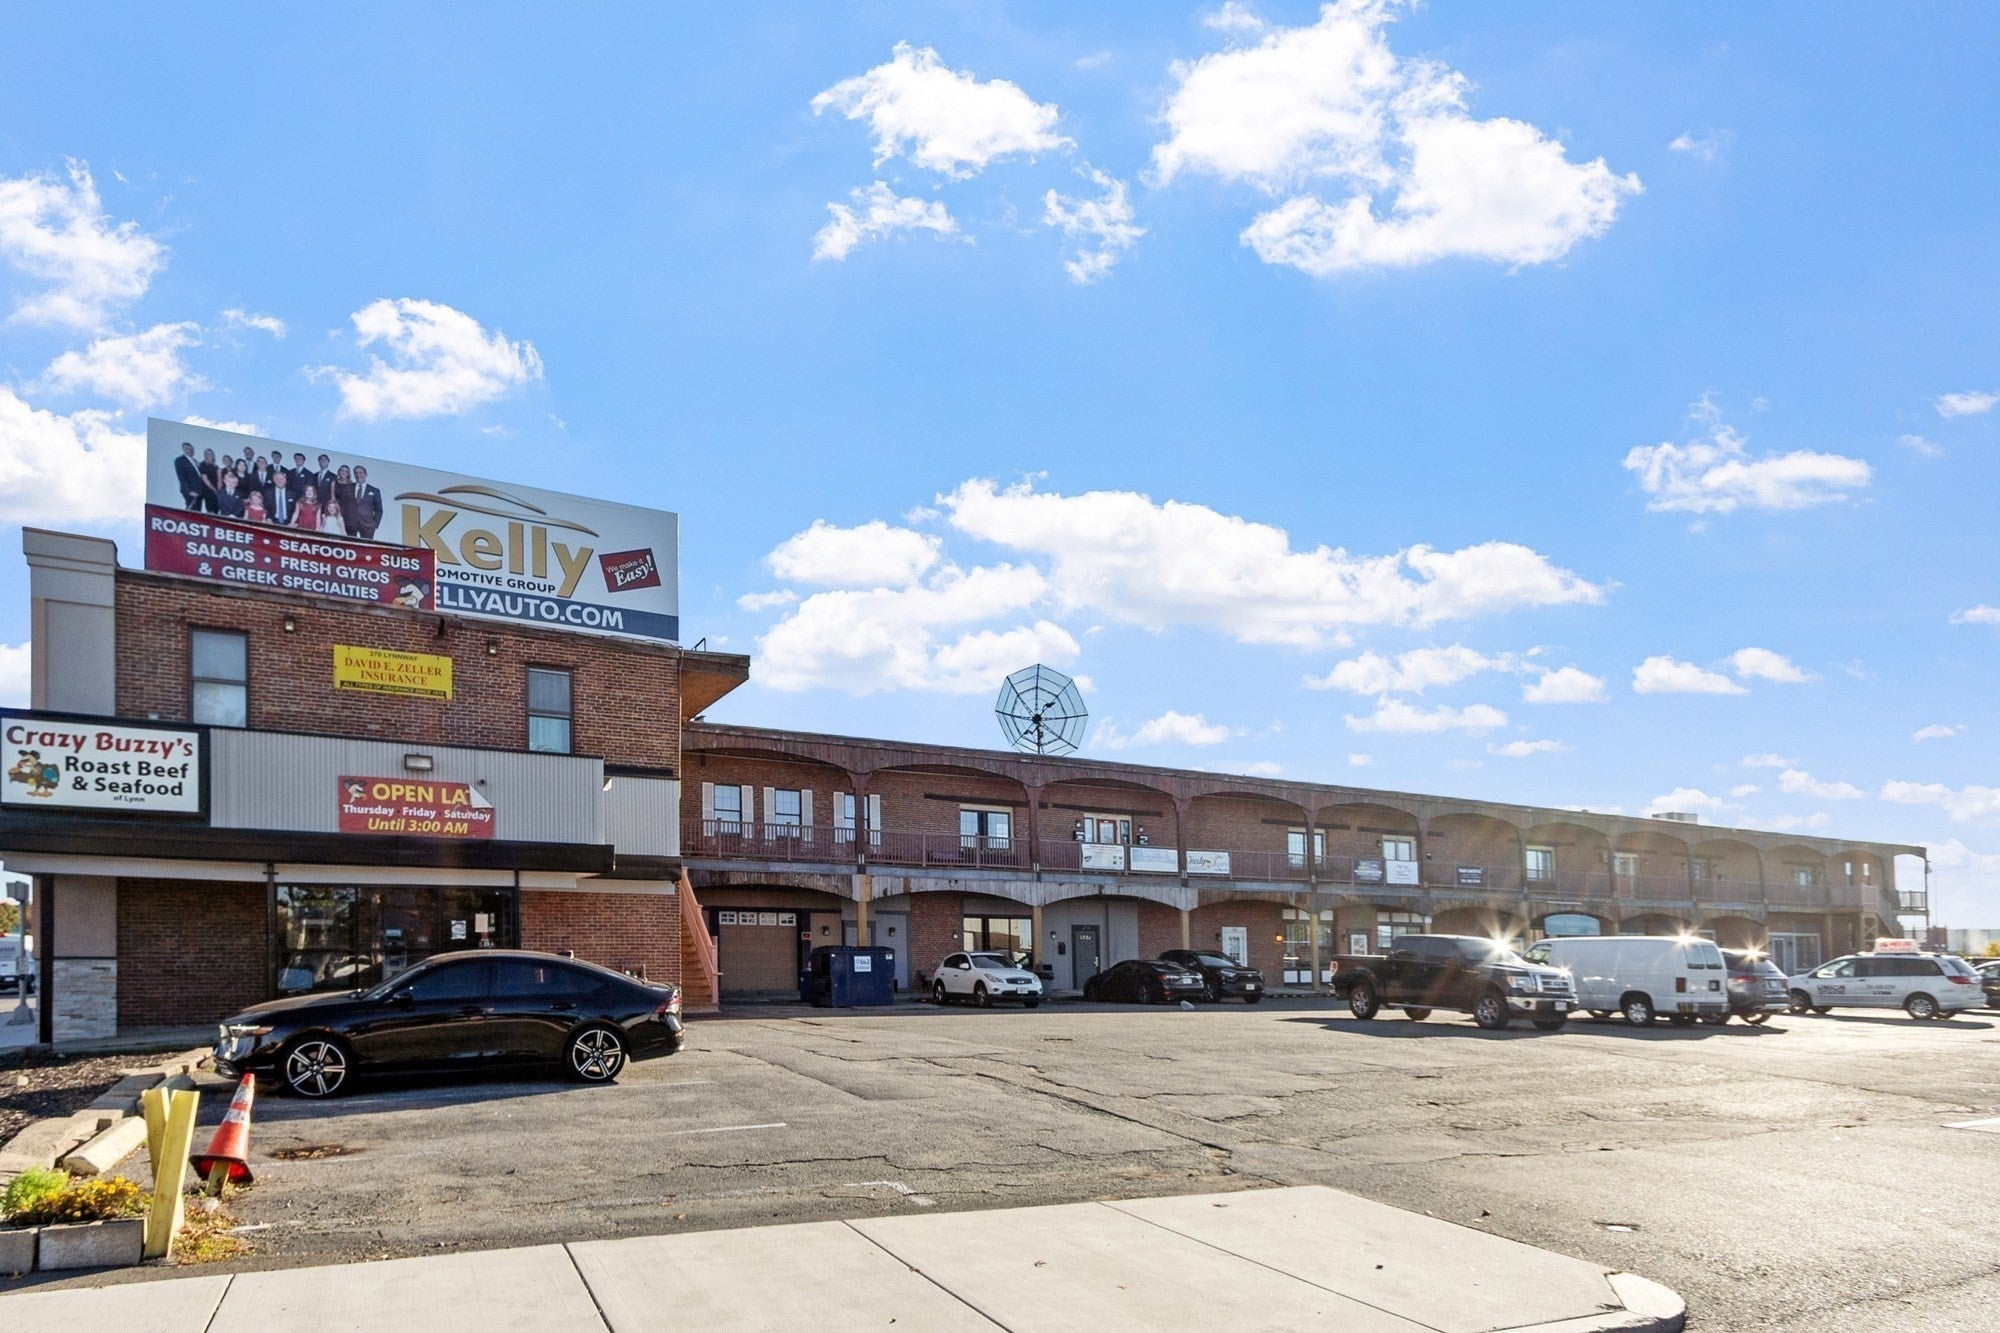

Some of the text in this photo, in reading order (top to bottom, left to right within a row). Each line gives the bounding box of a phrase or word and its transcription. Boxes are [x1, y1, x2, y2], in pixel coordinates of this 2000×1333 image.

[151, 517, 420, 571] ROAST BEEF SEAFOOD SUBS
[401, 503, 594, 598] Kelly
[186, 541, 390, 584] SALADS FRESH GYROS
[614, 555, 654, 587] Easy!
[198, 562, 379, 600] & GREEK SPECIALTIES
[437, 568, 556, 593] OMOTIVE GROUP
[436, 585, 624, 630] LLYAUTO.COM
[344, 657, 442, 676] DAVID E. ZELLER
[370, 650, 418, 661] 370 LYNNWAY
[361, 670, 428, 686] INSURANCE
[383, 685, 414, 693] INSURANCE
[6, 726, 194, 760] Crazy Buzzy's
[65, 756, 189, 778] Roast Beef
[72, 776, 183, 796] & Seafood
[372, 783, 469, 806] OPEN LA
[114, 794, 146, 803] of Lynn
[342, 804, 491, 822] Thursday Friday Saturday
[368, 818, 468, 834] Until 3:00 AM
